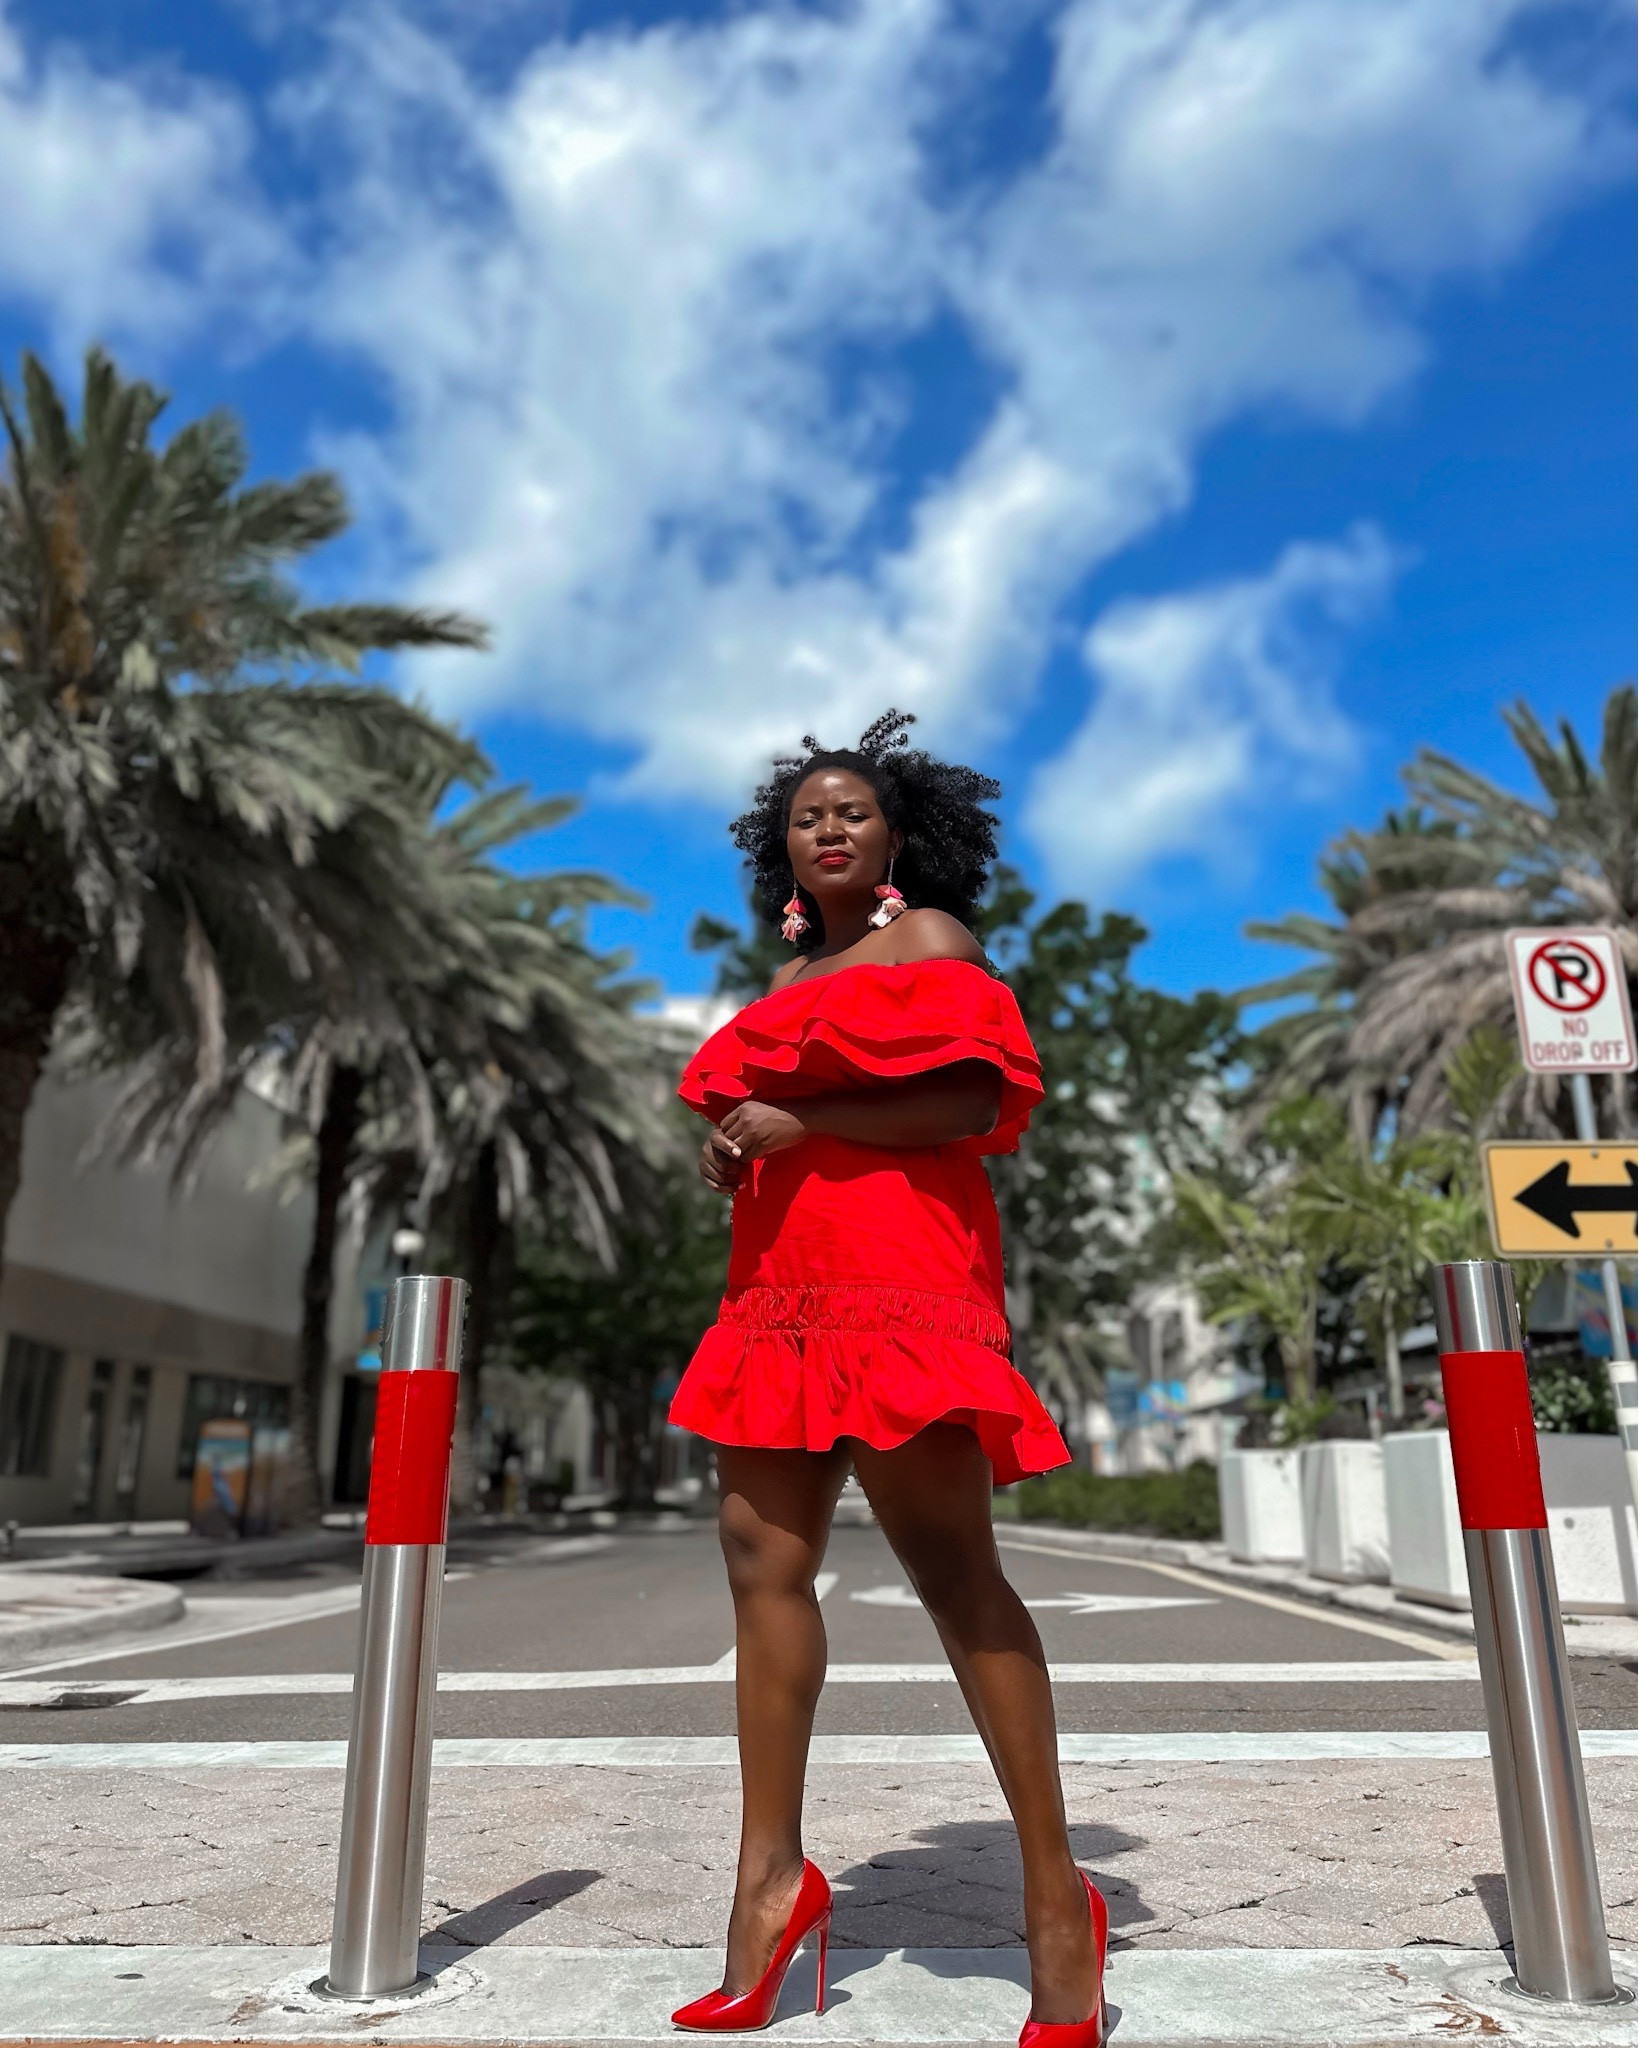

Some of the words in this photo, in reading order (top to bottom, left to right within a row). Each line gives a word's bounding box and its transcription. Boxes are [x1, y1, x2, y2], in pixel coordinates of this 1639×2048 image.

[1562, 1017, 1589, 1038] NO
[1533, 1041, 1584, 1062] DROP
[1590, 1040, 1624, 1061] OFF
